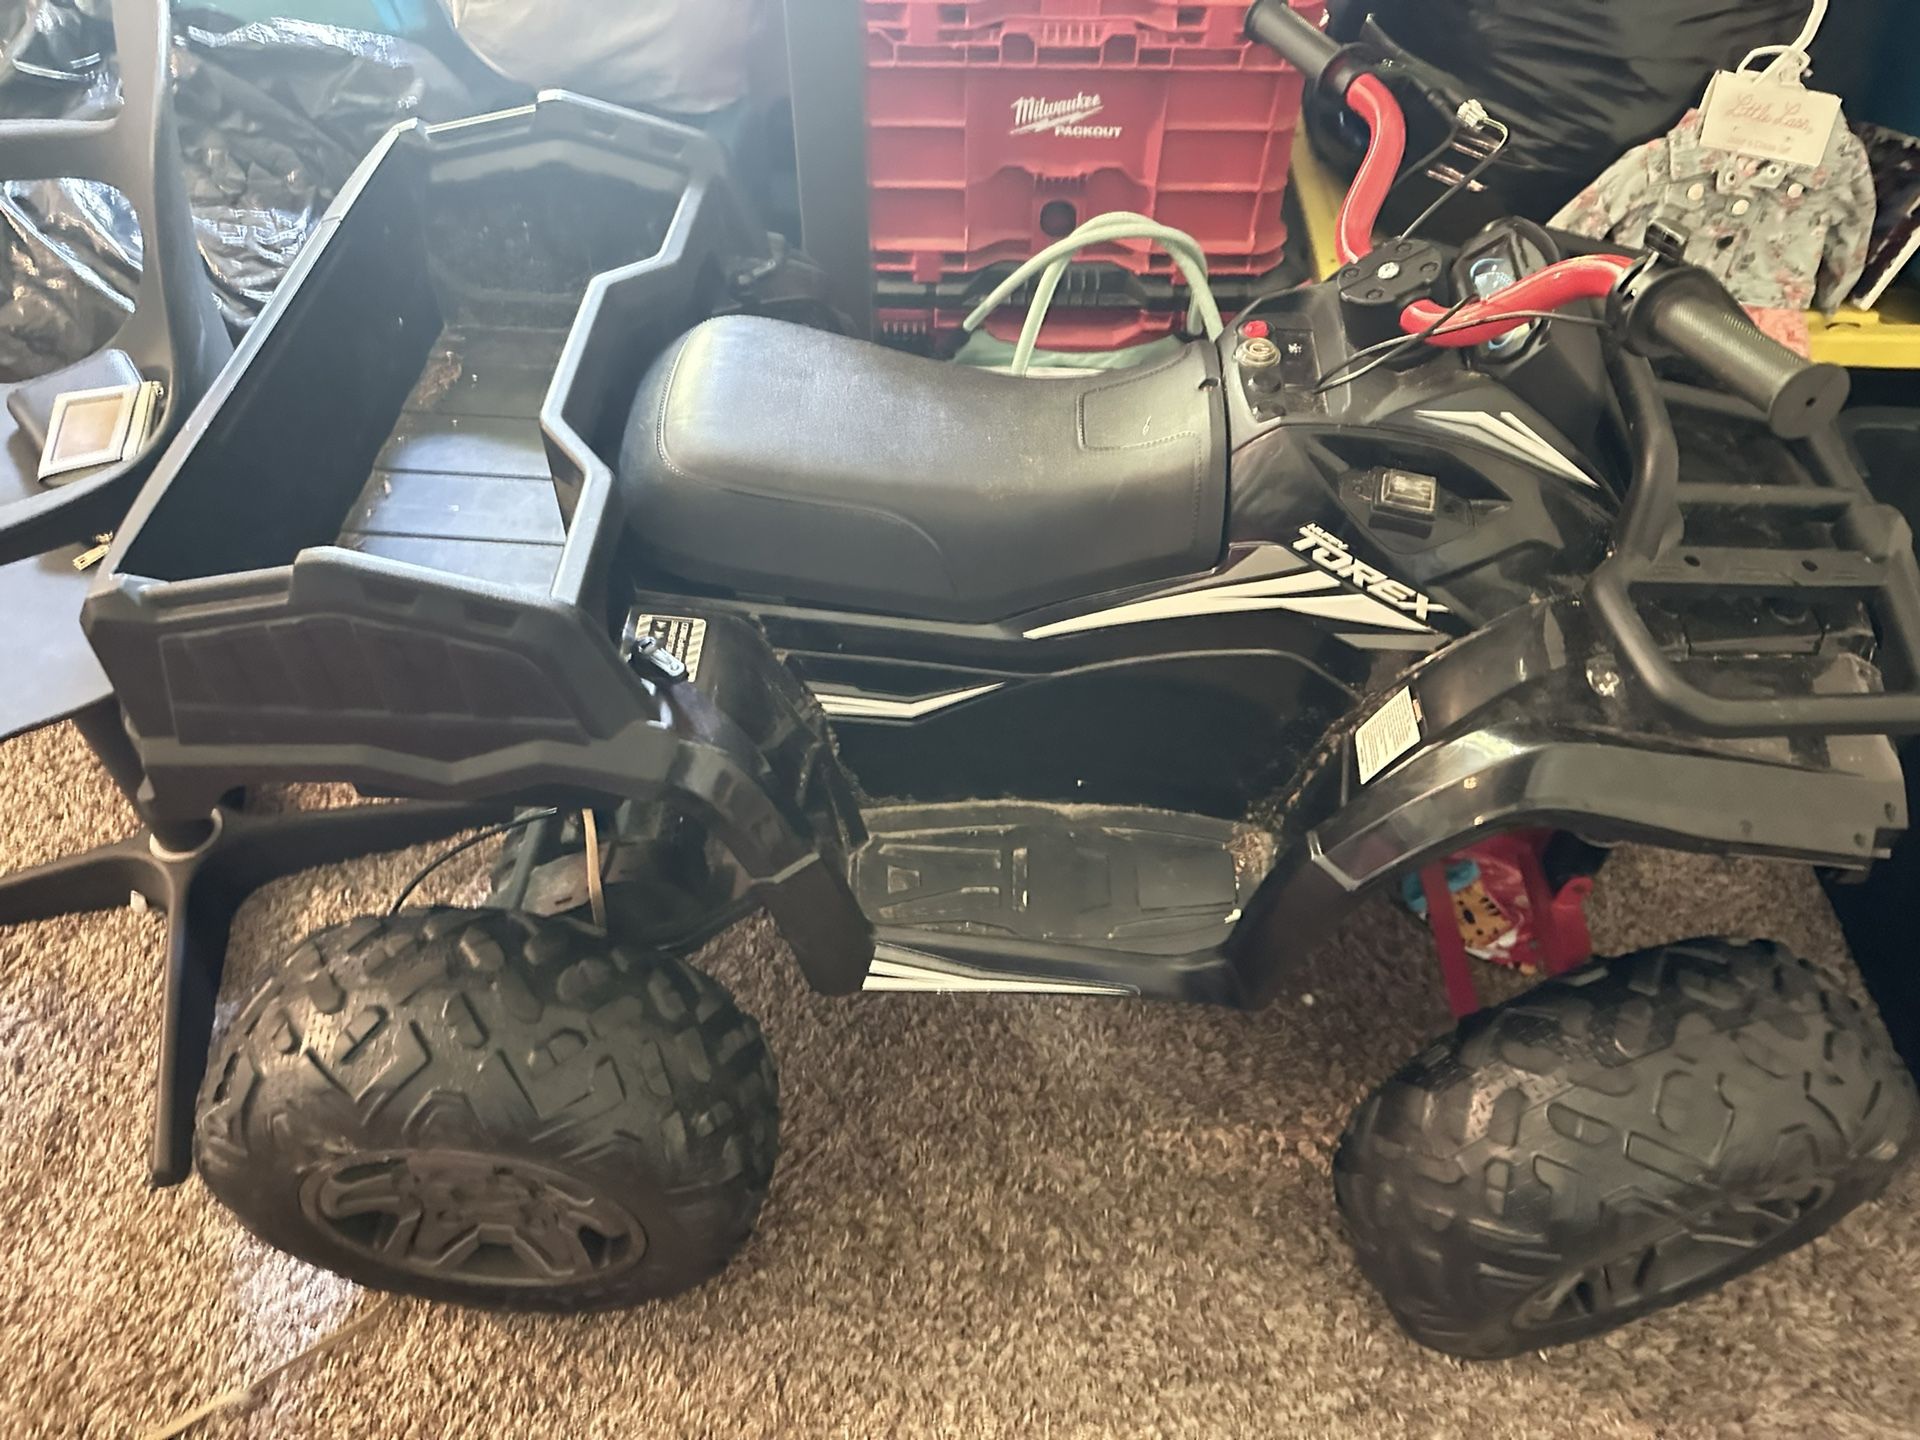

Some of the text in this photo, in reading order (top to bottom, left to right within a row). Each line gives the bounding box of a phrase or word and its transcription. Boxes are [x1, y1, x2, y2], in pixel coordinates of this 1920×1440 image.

[1010, 91, 1101, 126] Milwaukee
[1055, 126, 1122, 137] PACKOUT
[1292, 525, 1450, 621] TOREX
